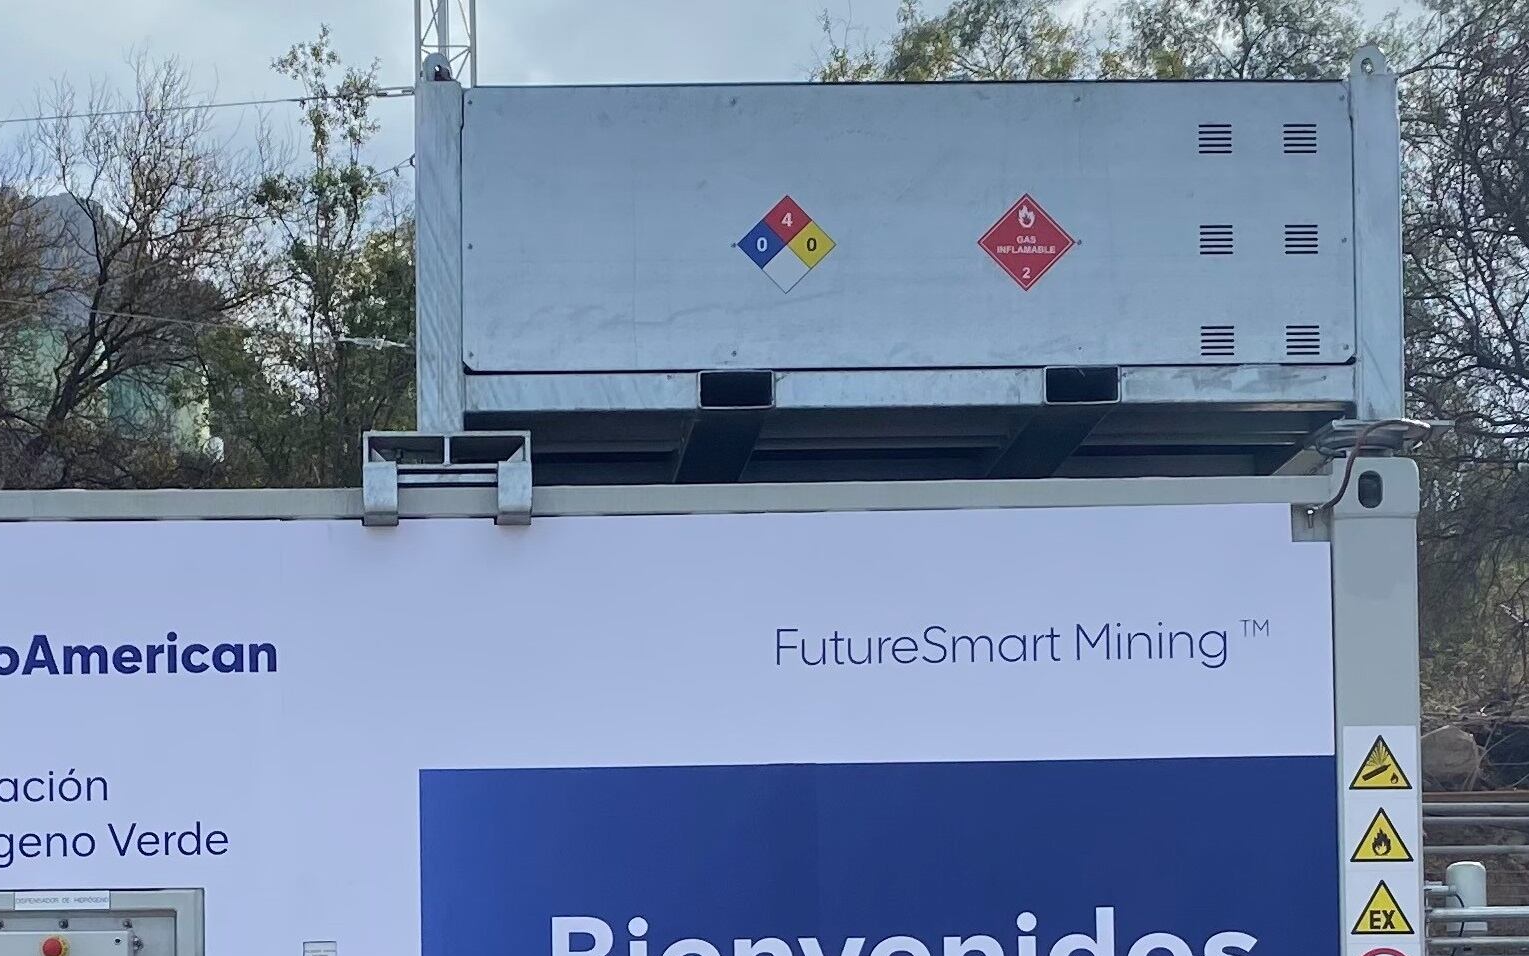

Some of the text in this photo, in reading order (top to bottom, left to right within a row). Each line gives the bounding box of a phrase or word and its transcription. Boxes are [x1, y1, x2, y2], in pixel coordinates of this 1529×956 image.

[781, 212, 793, 227] 4
[756, 237, 817, 253] 0 0
[1016, 235, 1037, 244] GAS
[996, 245, 1056, 254] INFLAMABLE
[1022, 267, 1031, 279] 2
[775, 625, 1062, 666] FutureSmart
[1075, 621, 1228, 669] Mining
[108, 822, 229, 857] Verde
[1370, 910, 1396, 930] EX
